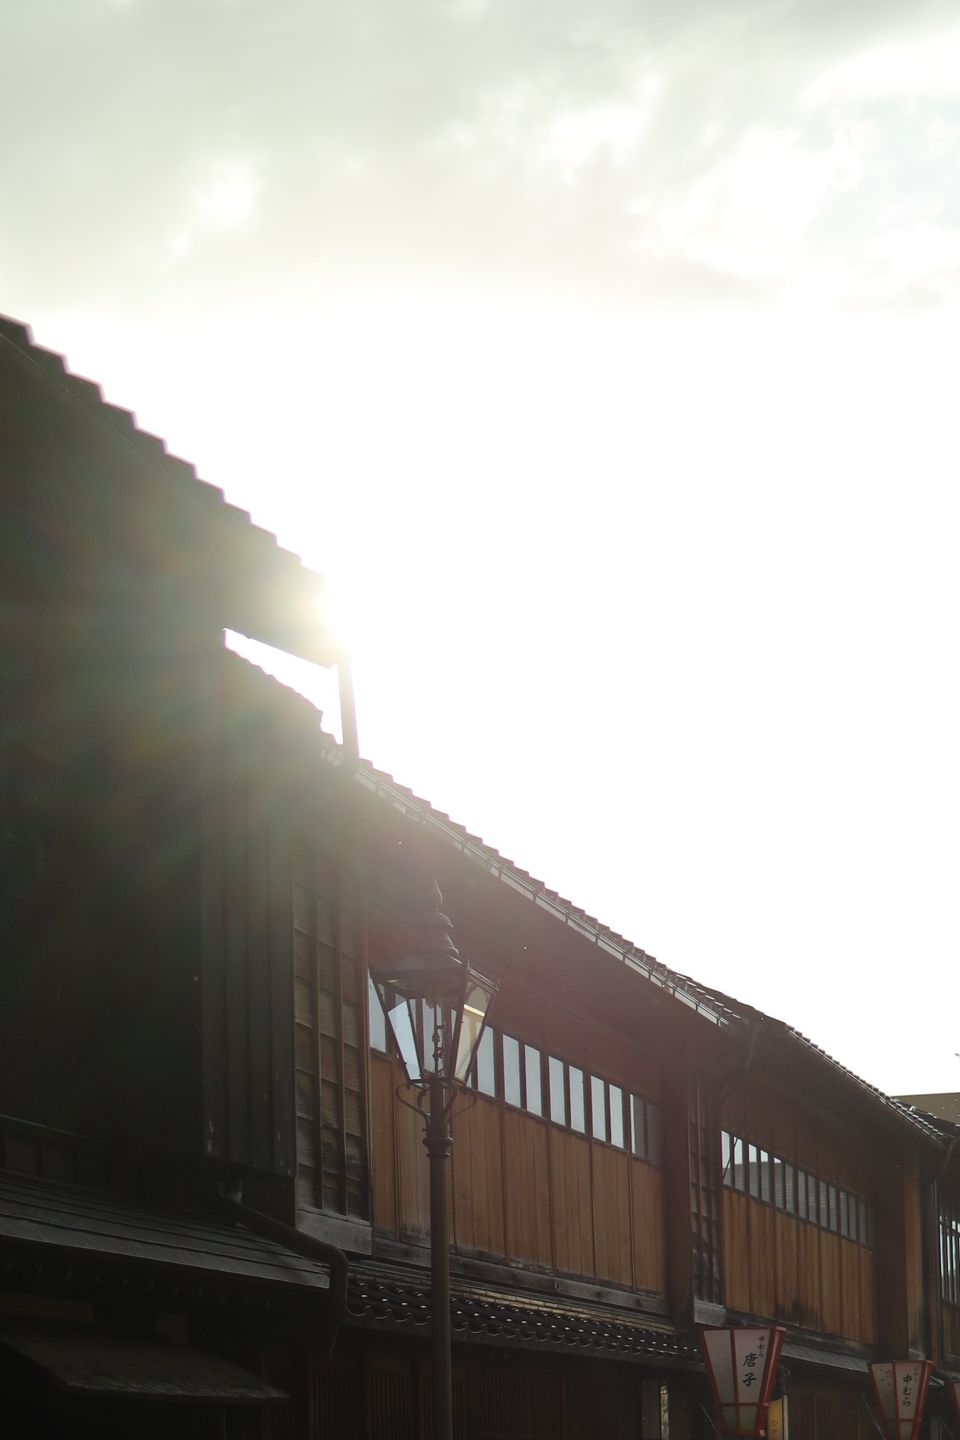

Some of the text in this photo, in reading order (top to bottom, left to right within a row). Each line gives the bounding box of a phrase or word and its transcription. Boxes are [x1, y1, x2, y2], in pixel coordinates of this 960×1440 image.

[742, 1352, 758, 1388] 唐子
[902, 1373, 913, 1408] 中むら
